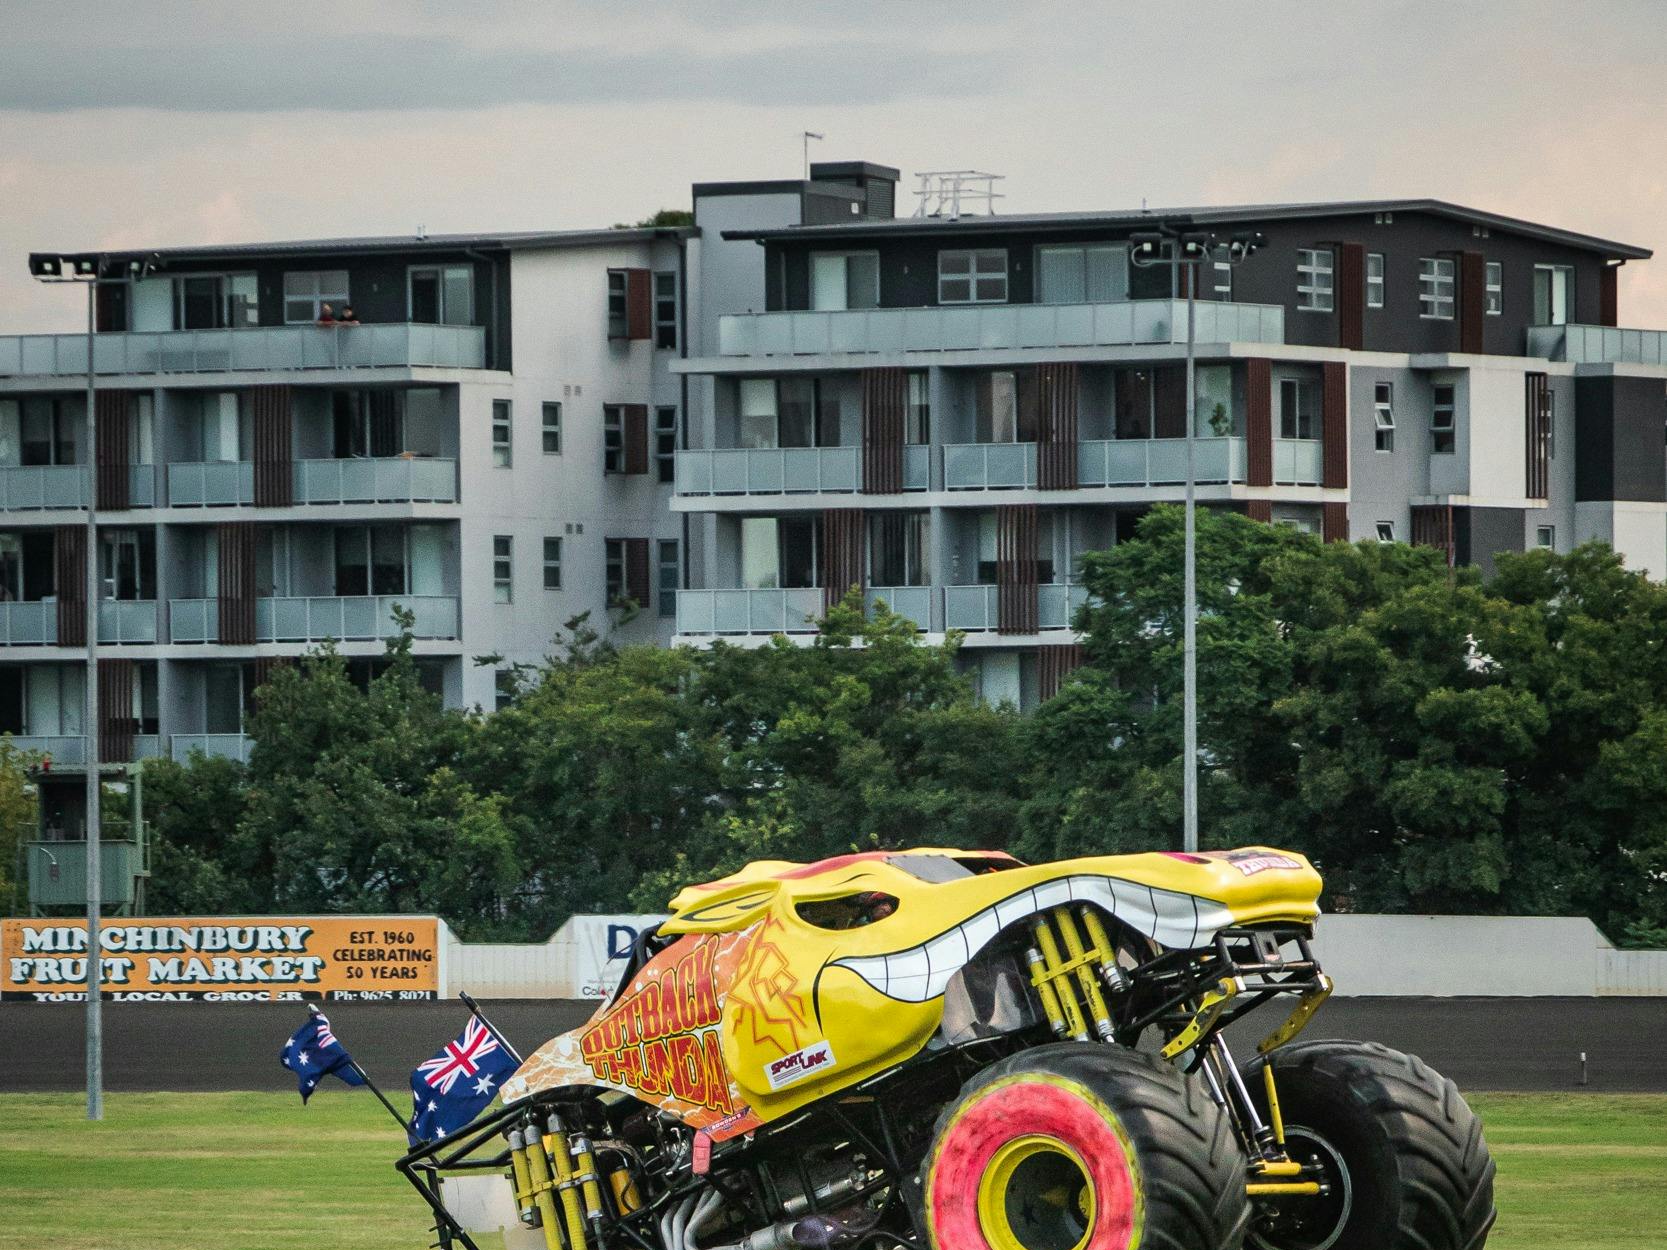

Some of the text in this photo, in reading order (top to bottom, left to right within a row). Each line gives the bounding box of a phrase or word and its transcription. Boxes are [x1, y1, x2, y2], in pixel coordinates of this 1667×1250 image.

[22, 926, 312, 953] MINCHINBURY
[349, 931, 415, 945] EST. 1960
[333, 948, 432, 962] CELEBRATING
[147, 957, 323, 984] MARKET
[346, 966, 418, 979] 50 YEARS
[32, 992, 102, 1002] YOU
[112, 992, 194, 1002] LOCAL
[580, 932, 723, 1056] OUTBACK
[582, 1031, 733, 1115] THUNDA
[771, 1051, 803, 1075] SPORT
[801, 1049, 828, 1069] LINK
